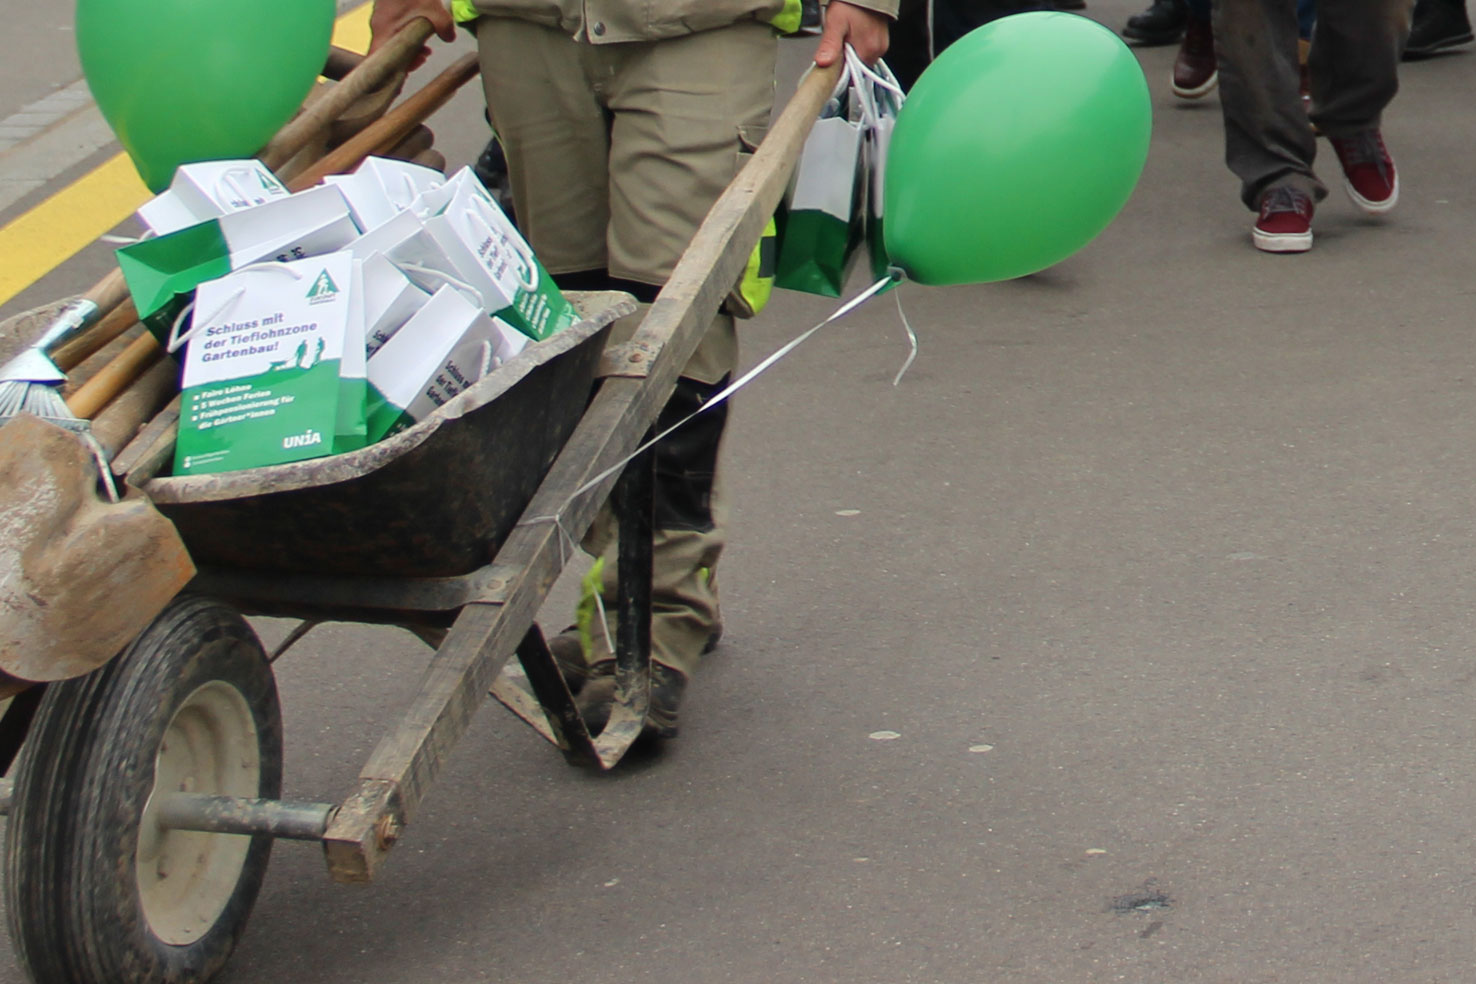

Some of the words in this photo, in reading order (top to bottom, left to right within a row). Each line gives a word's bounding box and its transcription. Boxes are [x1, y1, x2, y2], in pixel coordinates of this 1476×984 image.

[203, 339, 227, 350] der
[230, 322, 318, 345] Tieflohnzone
[206, 320, 259, 337] Schluss
[261, 312, 284, 327] mit
[201, 341, 280, 362] Gartenbau!
